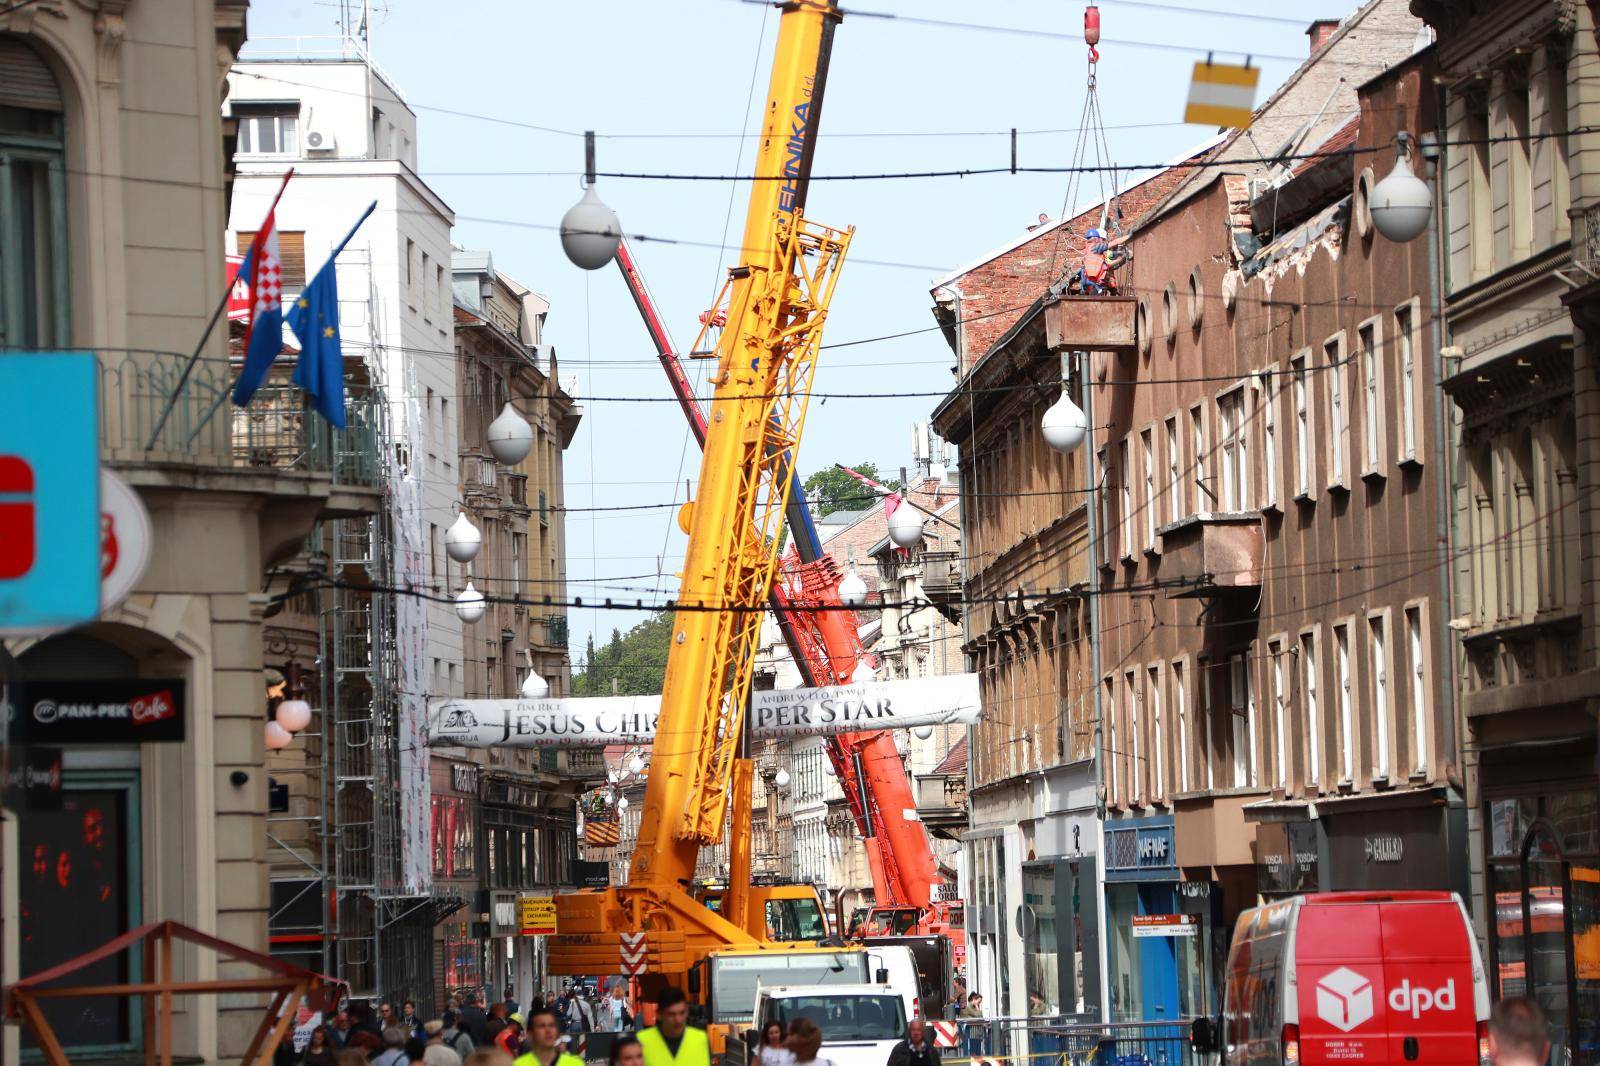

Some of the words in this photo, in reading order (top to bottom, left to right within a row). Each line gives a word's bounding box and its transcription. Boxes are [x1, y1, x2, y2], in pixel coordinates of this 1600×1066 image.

[778, 102, 811, 213] EHNIKA
[760, 692, 805, 703] ANDREW
[58, 703, 129, 718] PAN-PEK
[757, 703, 812, 727] PER
[820, 698, 895, 723] STAR
[500, 709, 585, 743] JESUS
[595, 710, 659, 736] CHR
[1139, 838, 1152, 858] NAF
[1152, 836, 1167, 857] NAF
[1296, 852, 1315, 863] TOSCA
[1264, 854, 1283, 865] TOSCA
[1388, 978, 1456, 1019] dpd
